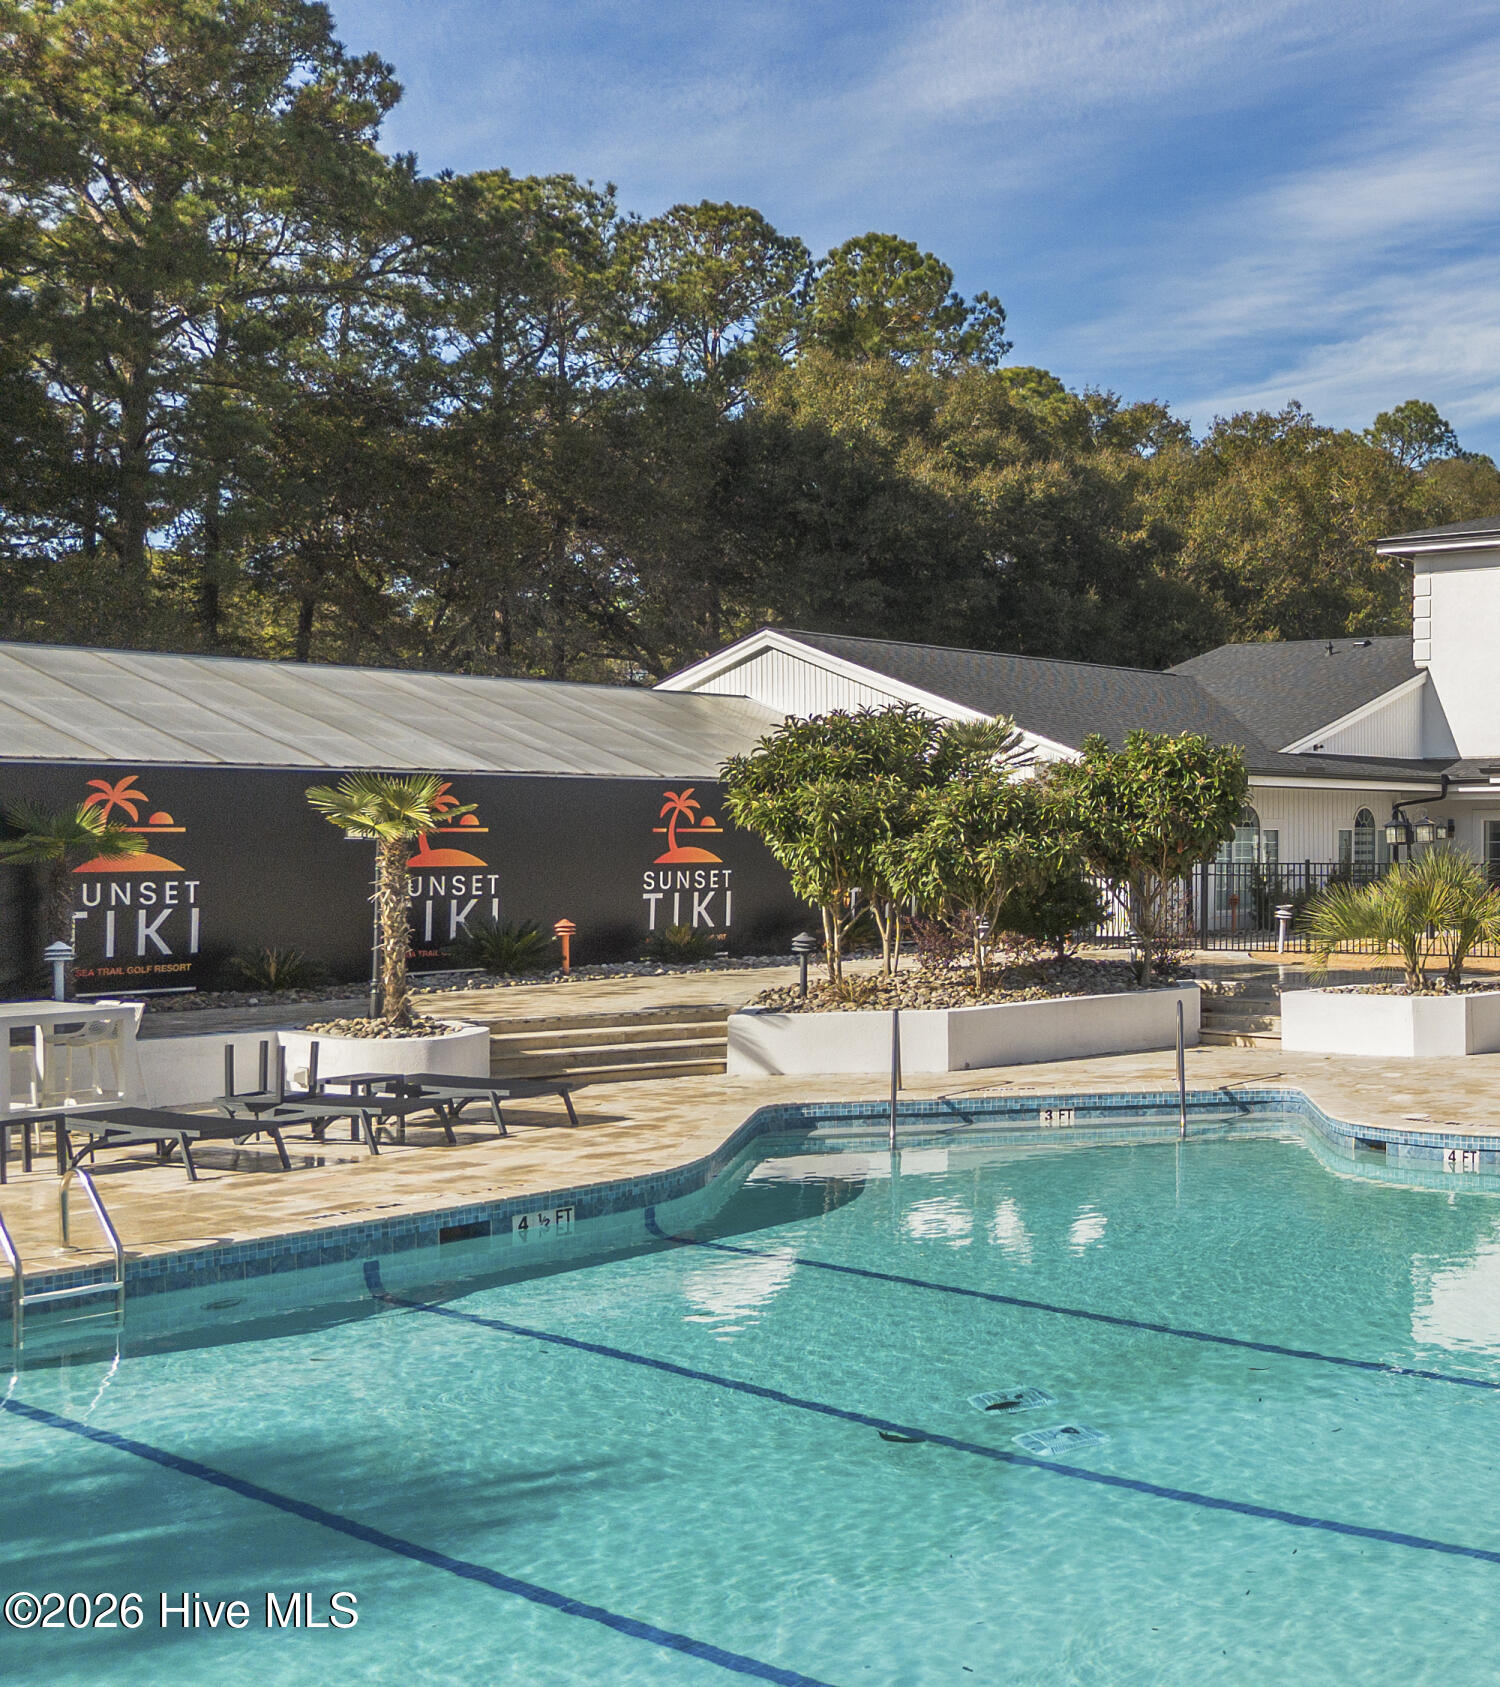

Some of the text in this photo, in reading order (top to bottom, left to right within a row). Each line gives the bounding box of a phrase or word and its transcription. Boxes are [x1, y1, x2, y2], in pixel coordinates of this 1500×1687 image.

[406, 874, 499, 897] UNSET
[643, 869, 732, 890] SUNSET
[82, 881, 200, 907] UNSET
[407, 898, 499, 942] IKI
[642, 890, 732, 930] TIKI
[75, 963, 192, 977] SEA TRAIL GOLF RESORT
[1045, 1109, 1072, 1120] 3 FT
[1448, 1150, 1477, 1162] 4 FT
[518, 1216, 529, 1230] 4
[556, 1208, 573, 1225] FT
